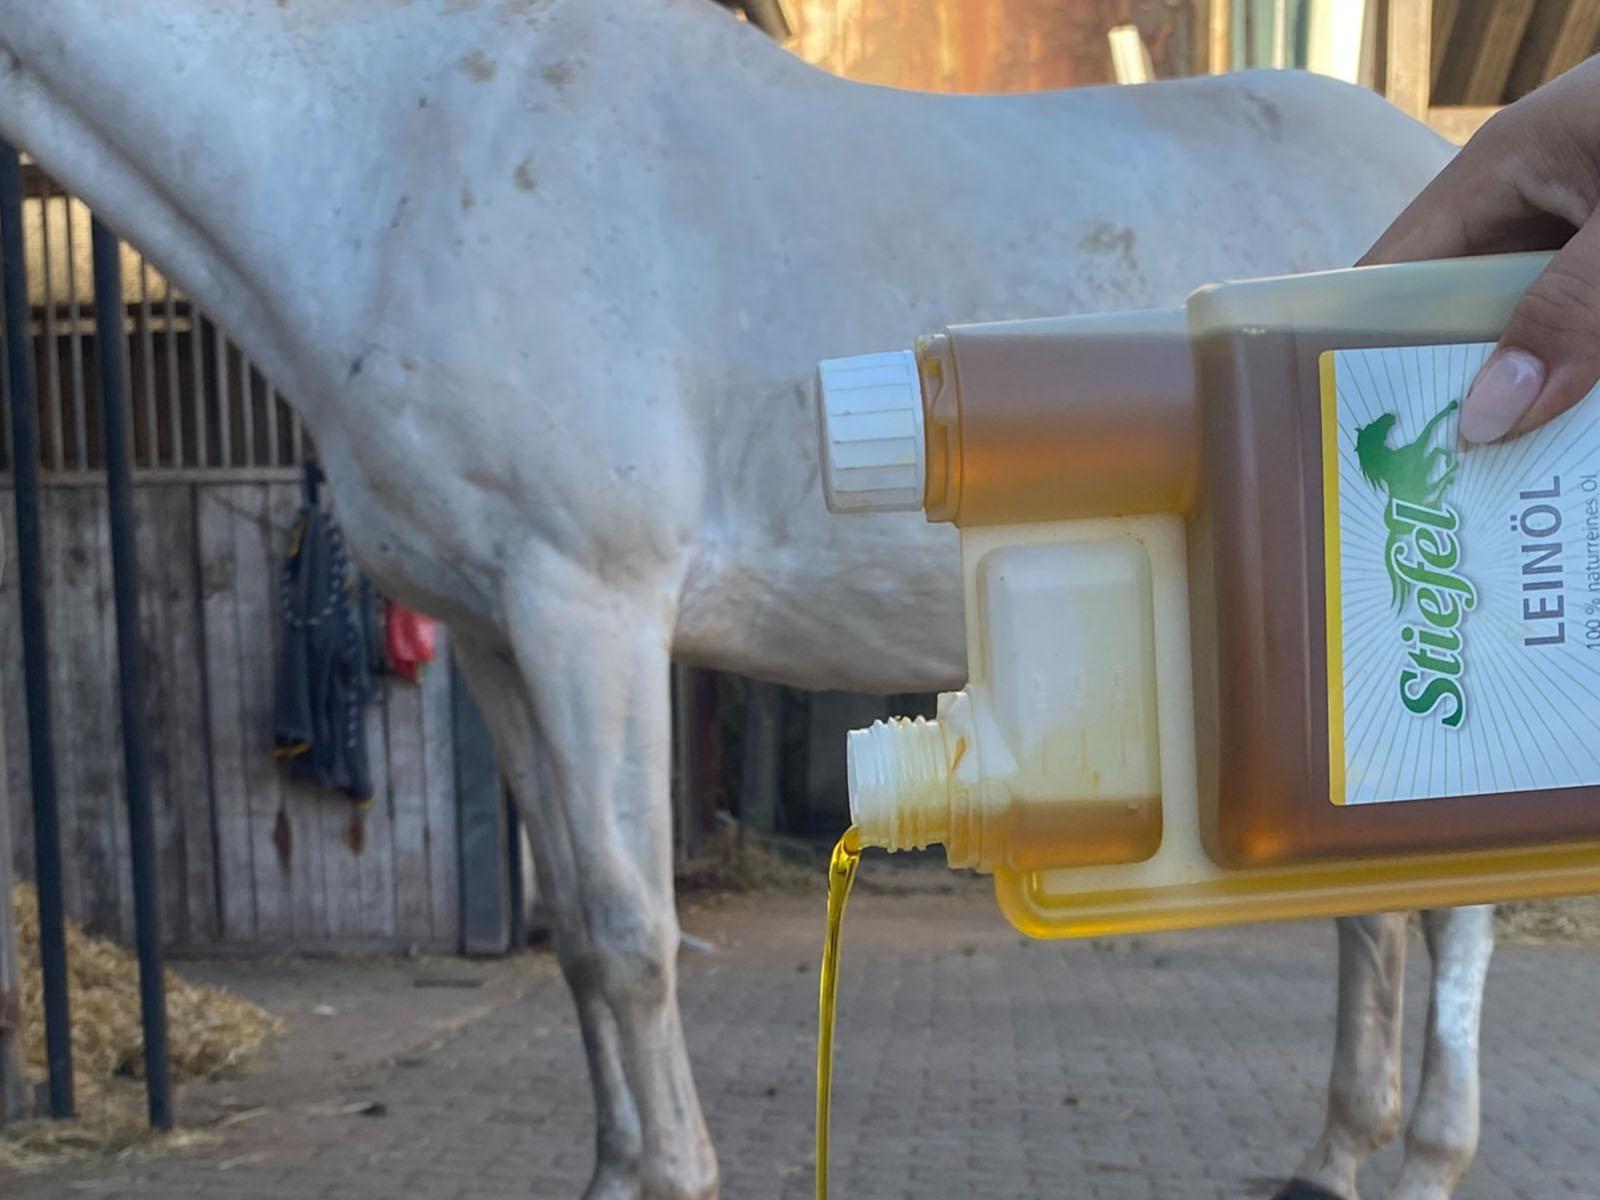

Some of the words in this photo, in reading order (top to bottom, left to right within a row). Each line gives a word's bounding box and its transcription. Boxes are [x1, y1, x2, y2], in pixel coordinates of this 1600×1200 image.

[1577, 474, 1598, 492] Öl
[1510, 475, 1565, 646] LEINÖL
[1582, 498, 1600, 592] naturreines
[1393, 500, 1476, 730] Stiefel
[1585, 598, 1600, 615] %
[1585, 619, 1600, 649] 100
